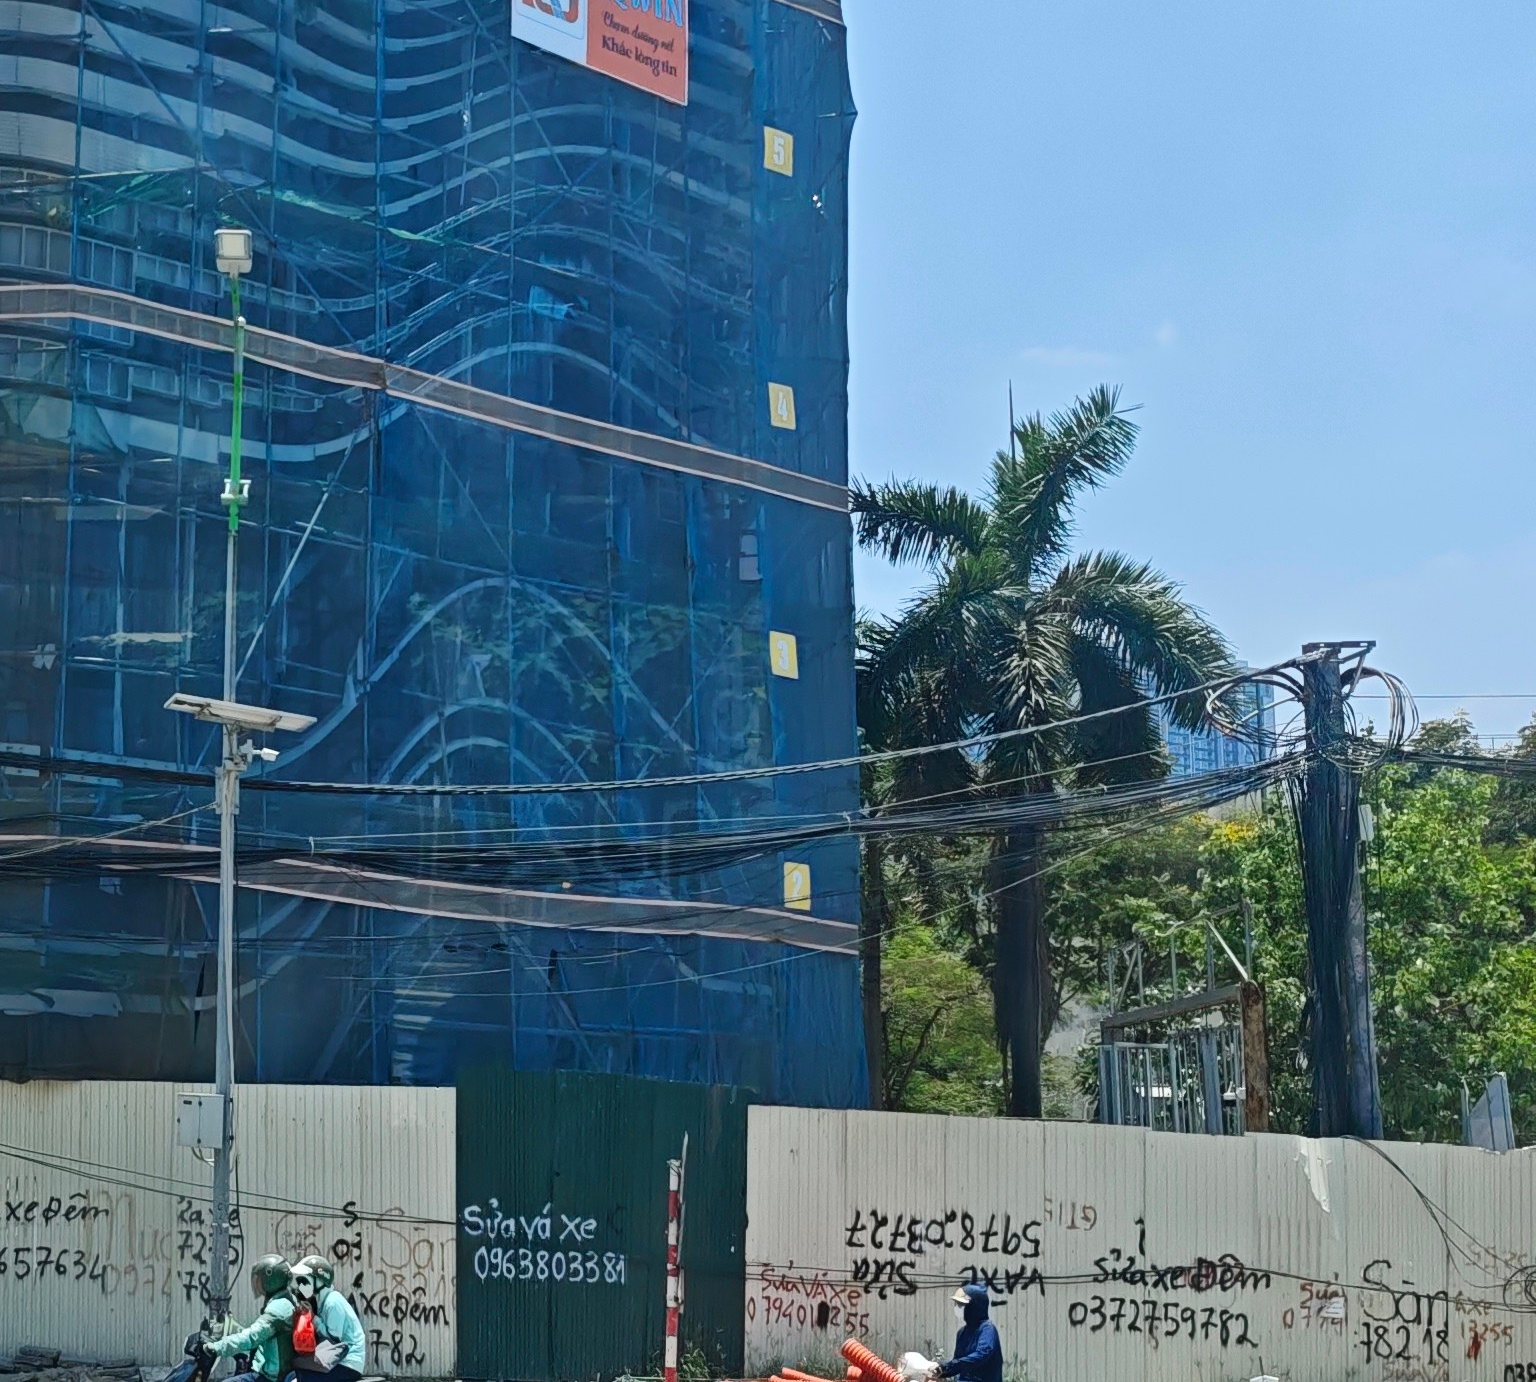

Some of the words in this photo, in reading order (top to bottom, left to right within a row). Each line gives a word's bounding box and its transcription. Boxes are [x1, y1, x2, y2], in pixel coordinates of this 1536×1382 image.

[661, 60, 678, 78] tin
[772, 135, 784, 166] 5
[777, 392, 789, 421] 4
[777, 640, 790, 670] 3
[790, 870, 803, 899] 2
[464, 1198, 516, 1239] Sửa
[520, 1202, 552, 1242] vá
[475, 1246, 625, 1284] 0963803381
[747, 1296, 870, 1338] 079401255
[1068, 1295, 1258, 1347] 0372759782
